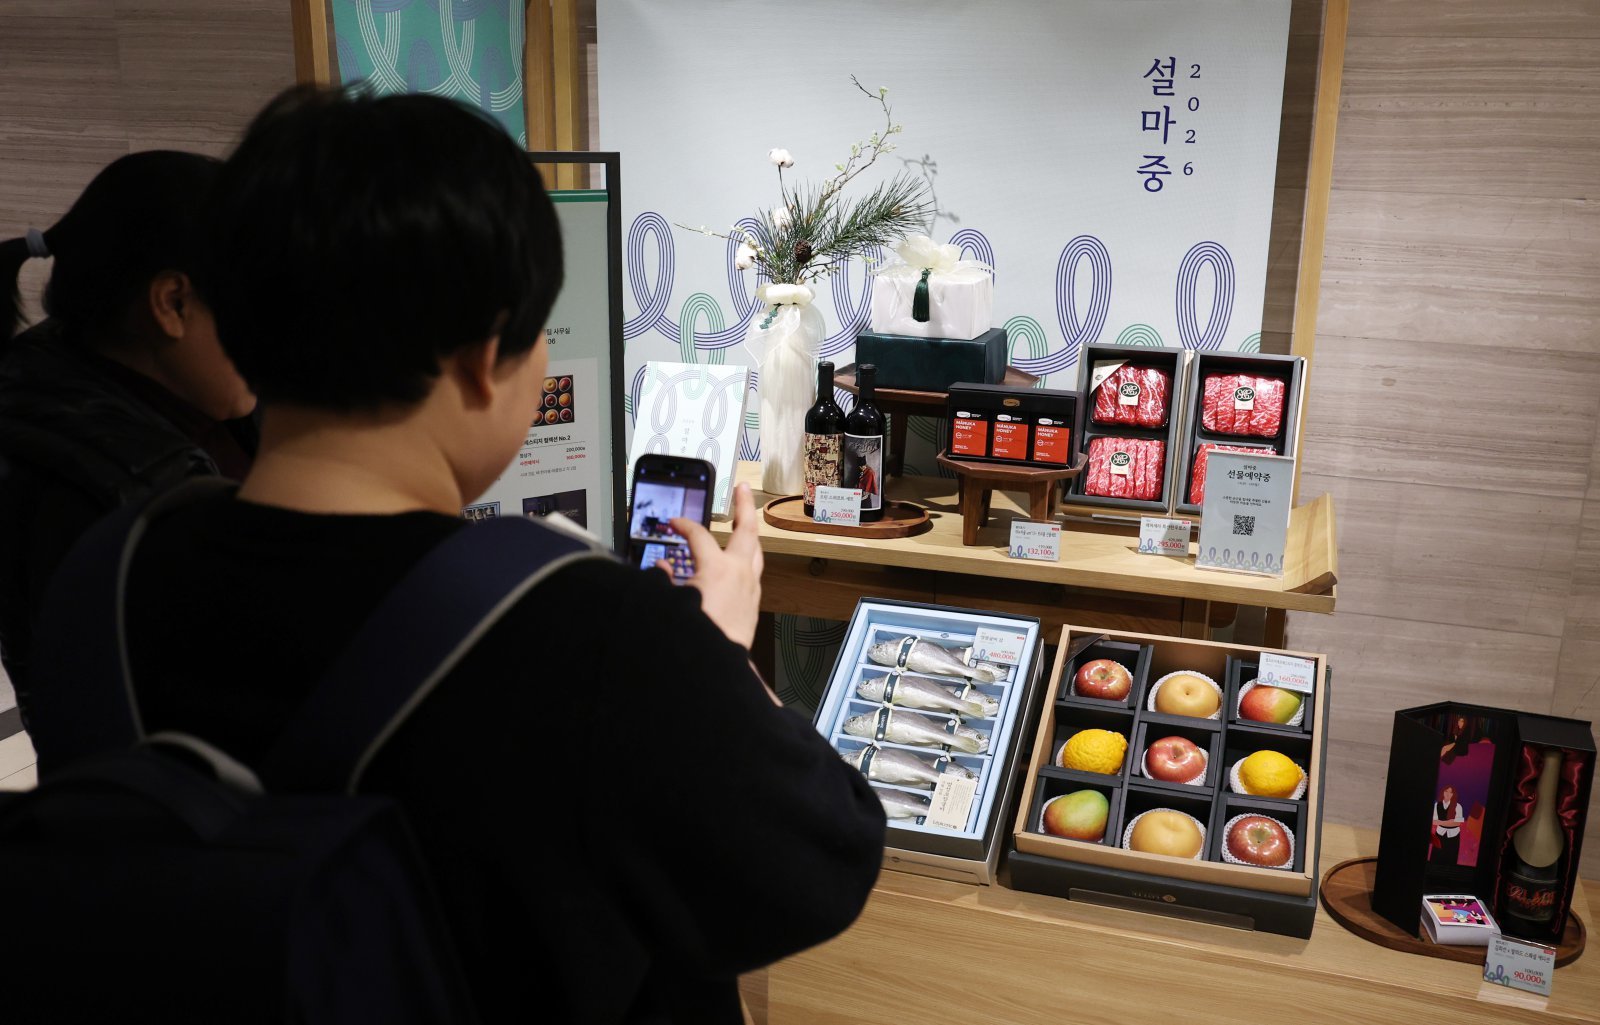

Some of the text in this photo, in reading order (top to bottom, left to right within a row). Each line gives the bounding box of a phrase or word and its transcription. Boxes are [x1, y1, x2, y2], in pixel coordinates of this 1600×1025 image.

[1136, 56, 1177, 193] 설마중
[1183, 63, 1201, 177] 2026
[553, 327, 571, 335] 사무실
[1227, 469, 1271, 483] 선물예약중
[830, 511, 856, 519] 250,000원
[1027, 548, 1055, 556] 132,100원
[1513, 970, 1547, 985] 90,000원
